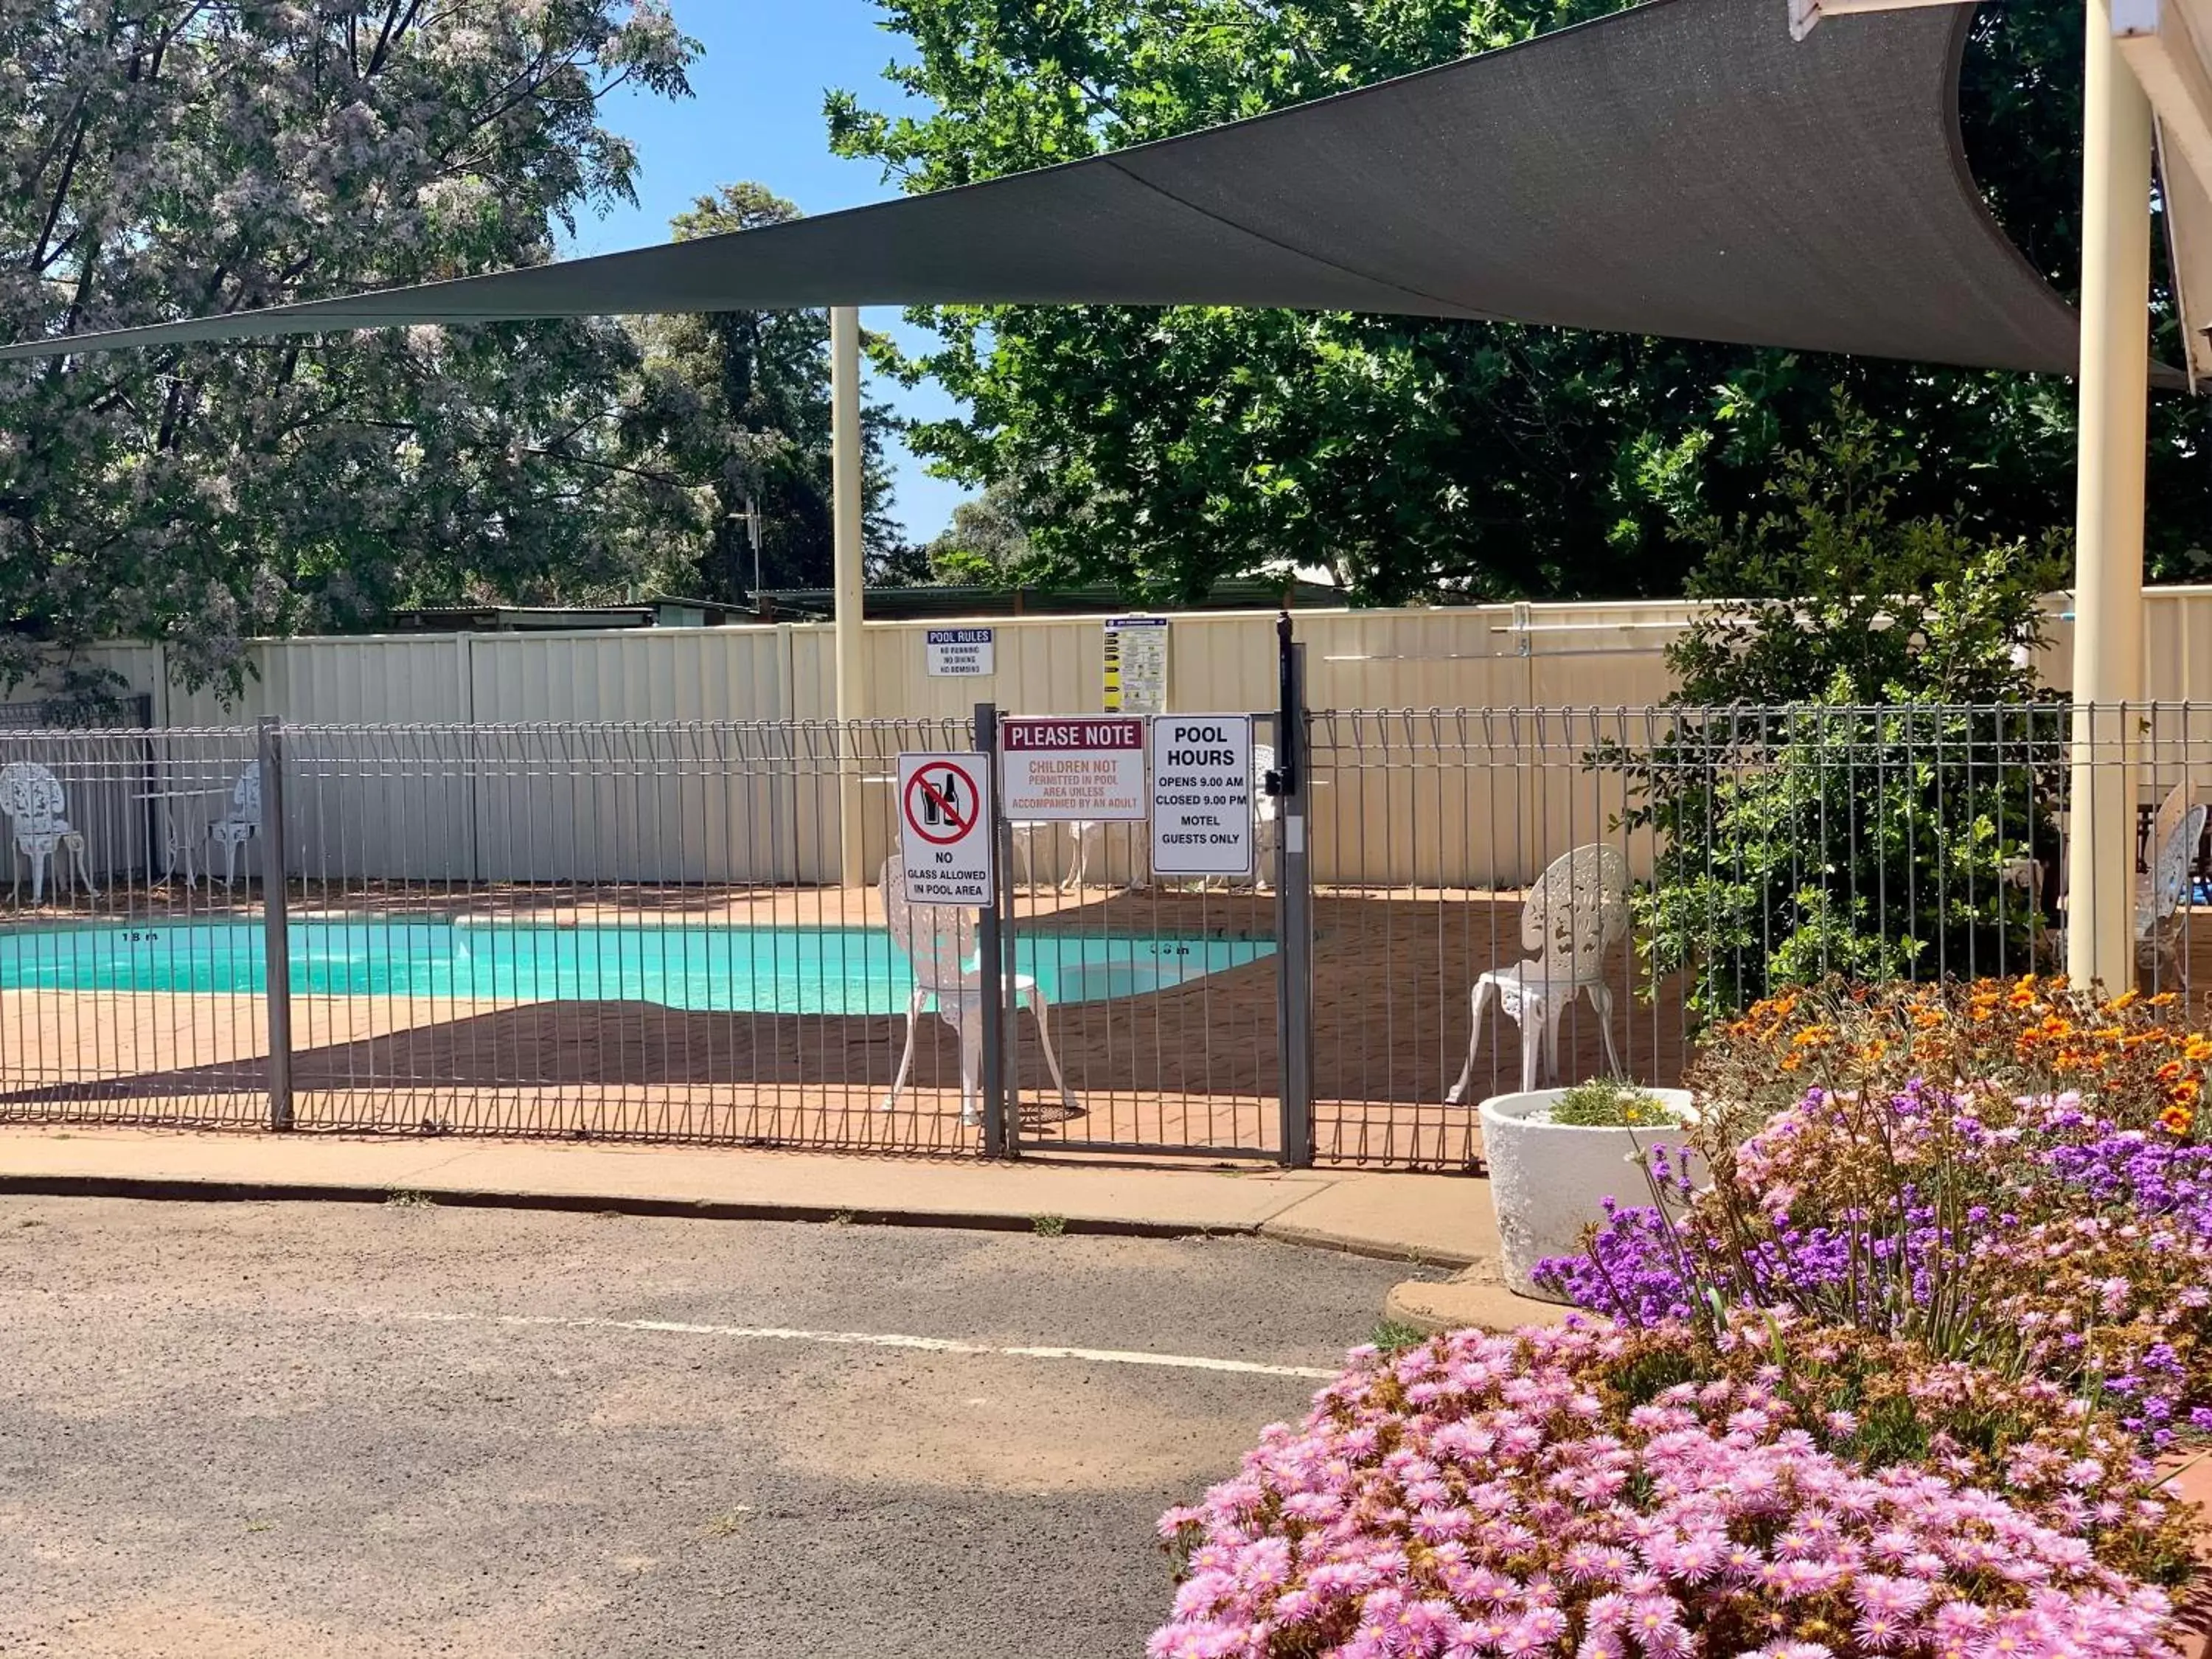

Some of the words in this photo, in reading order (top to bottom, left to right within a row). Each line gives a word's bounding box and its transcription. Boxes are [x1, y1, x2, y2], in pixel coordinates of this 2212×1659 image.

[930, 632, 956, 642] POOL
[958, 630, 989, 641] RULES
[1012, 726, 1079, 745] PLEASE
[1086, 725, 1134, 745] NOTE
[1175, 727, 1228, 742] POOL
[1167, 750, 1235, 766] HOURS
[1029, 760, 1089, 773] CHILDREN
[1093, 760, 1117, 773] NOT
[1029, 775, 1079, 785] PERMITTED
[1082, 775, 1092, 785] IN
[1094, 775, 1119, 785] POOL
[1158, 776, 1197, 787] OPENS
[1200, 776, 1222, 787] 9.00
[1225, 776, 1244, 787] AM
[1043, 787, 1067, 797] AREA
[1069, 786, 1104, 796] UNLESS
[1012, 799, 1075, 809] ACCOMPANIED
[1079, 799, 1090, 809] BY
[1093, 799, 1105, 808] AN
[1108, 798, 1137, 808] ADULT
[1155, 796, 1200, 805] CLOSED
[1203, 796, 1226, 805] 9.00
[1229, 796, 1247, 805] PM
[1180, 815, 1220, 826] MOTEL
[1162, 834, 1207, 844] GUESTS
[1210, 834, 1239, 844] ONLY
[936, 852, 953, 863] NO
[908, 869, 937, 879] GLASS
[940, 869, 986, 880] ALLOWED
[914, 885, 924, 894] IN
[927, 885, 953, 895] POOL
[955, 886, 983, 896] AREA
